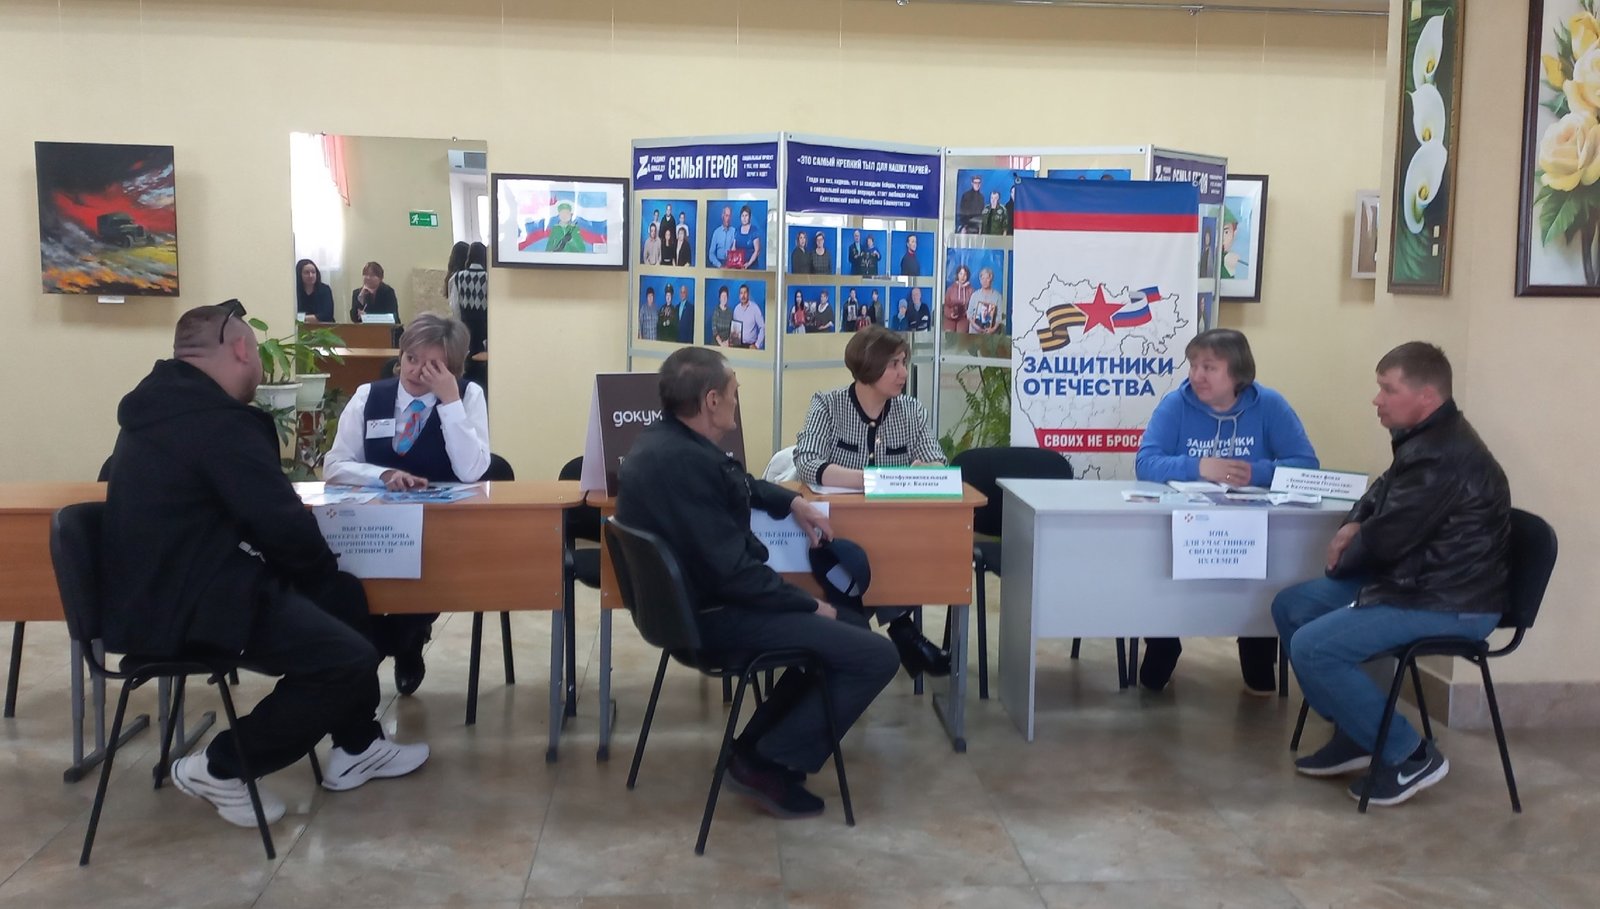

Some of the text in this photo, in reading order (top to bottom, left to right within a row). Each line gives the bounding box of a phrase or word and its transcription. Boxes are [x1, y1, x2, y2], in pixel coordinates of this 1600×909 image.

[668, 154, 738, 180] СЕМЬЯ ГЕРОЯ
[812, 156, 836, 167] САМЫЙ
[836, 158, 862, 170] КРЕПКИЙ
[862, 160, 876, 170] ТЫЛ
[876, 161, 888, 172] ДЛЯ
[888, 162, 907, 173] НАШИХ
[1023, 356, 1174, 376] ЗАЩИТНИКИ
[1023, 378, 1156, 397] ОТЕЧЕСТВА
[612, 409, 663, 428] докум
[1044, 434, 1084, 448] СВОИХ
[1087, 434, 1103, 448] НЕ
[1186, 436, 1255, 449] ЗАЩТНКИ
[1188, 446, 1250, 458] ОТЕЕСВА
[1183, 539, 1256, 547] ДЛЯ УЧАСТНИКОВ
